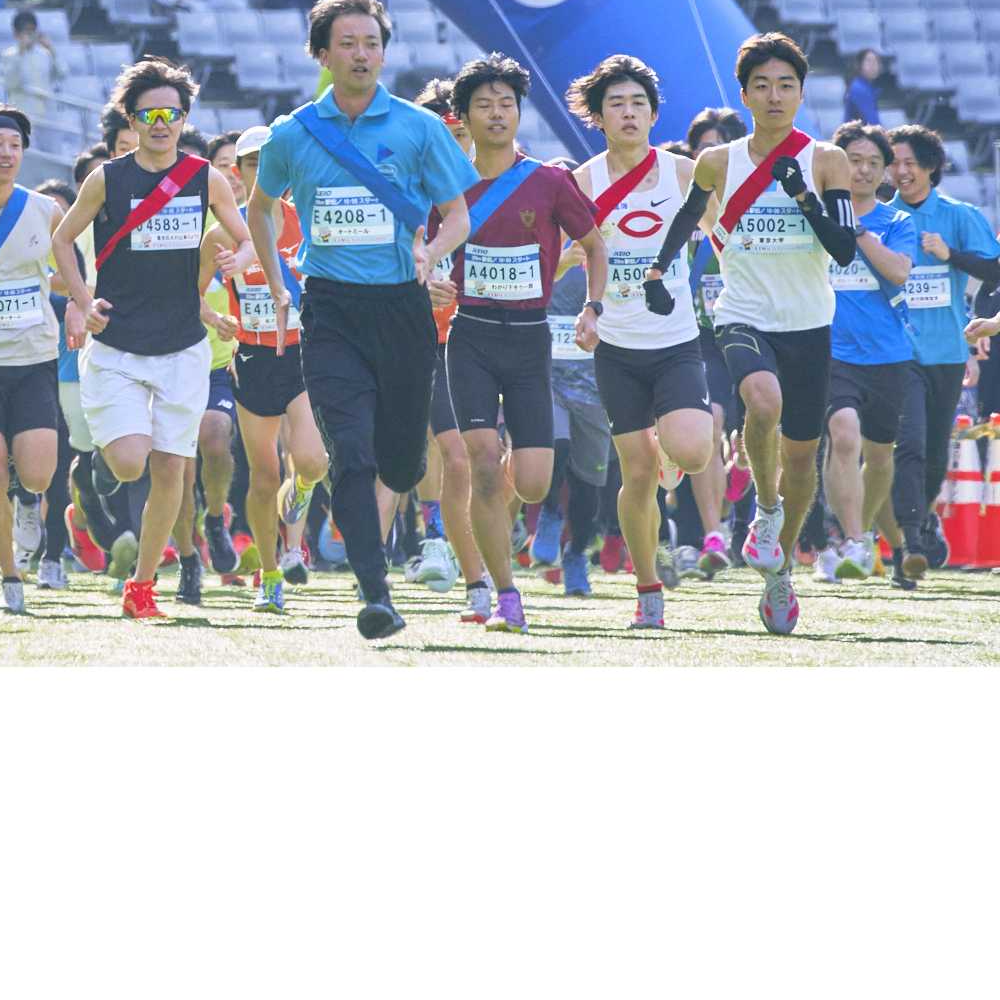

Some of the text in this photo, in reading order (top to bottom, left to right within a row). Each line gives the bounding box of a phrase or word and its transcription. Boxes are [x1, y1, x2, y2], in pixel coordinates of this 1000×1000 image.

[313, 208, 386, 225] E4208-1
[736, 217, 806, 233] A5002-1
[468, 264, 535, 281] A4018-1
